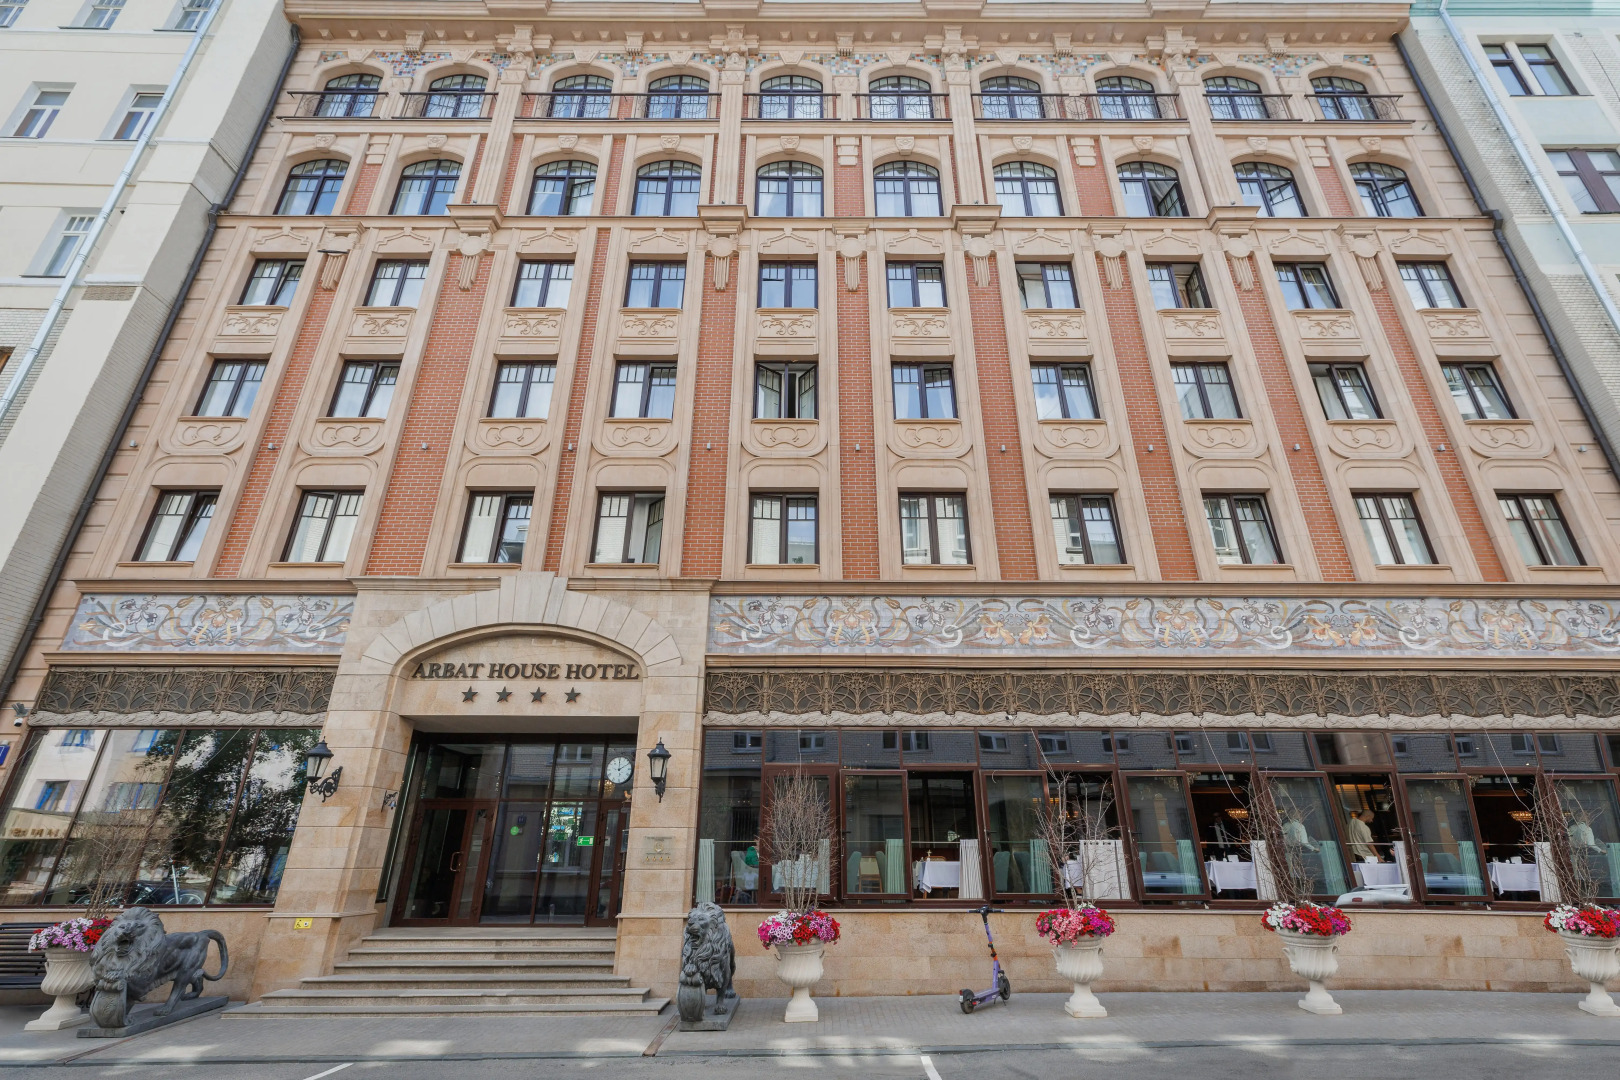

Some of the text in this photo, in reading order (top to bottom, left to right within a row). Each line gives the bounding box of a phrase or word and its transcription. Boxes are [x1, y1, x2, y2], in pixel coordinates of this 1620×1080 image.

[411, 662, 639, 680] ARBAT HOUSE HOTEL
